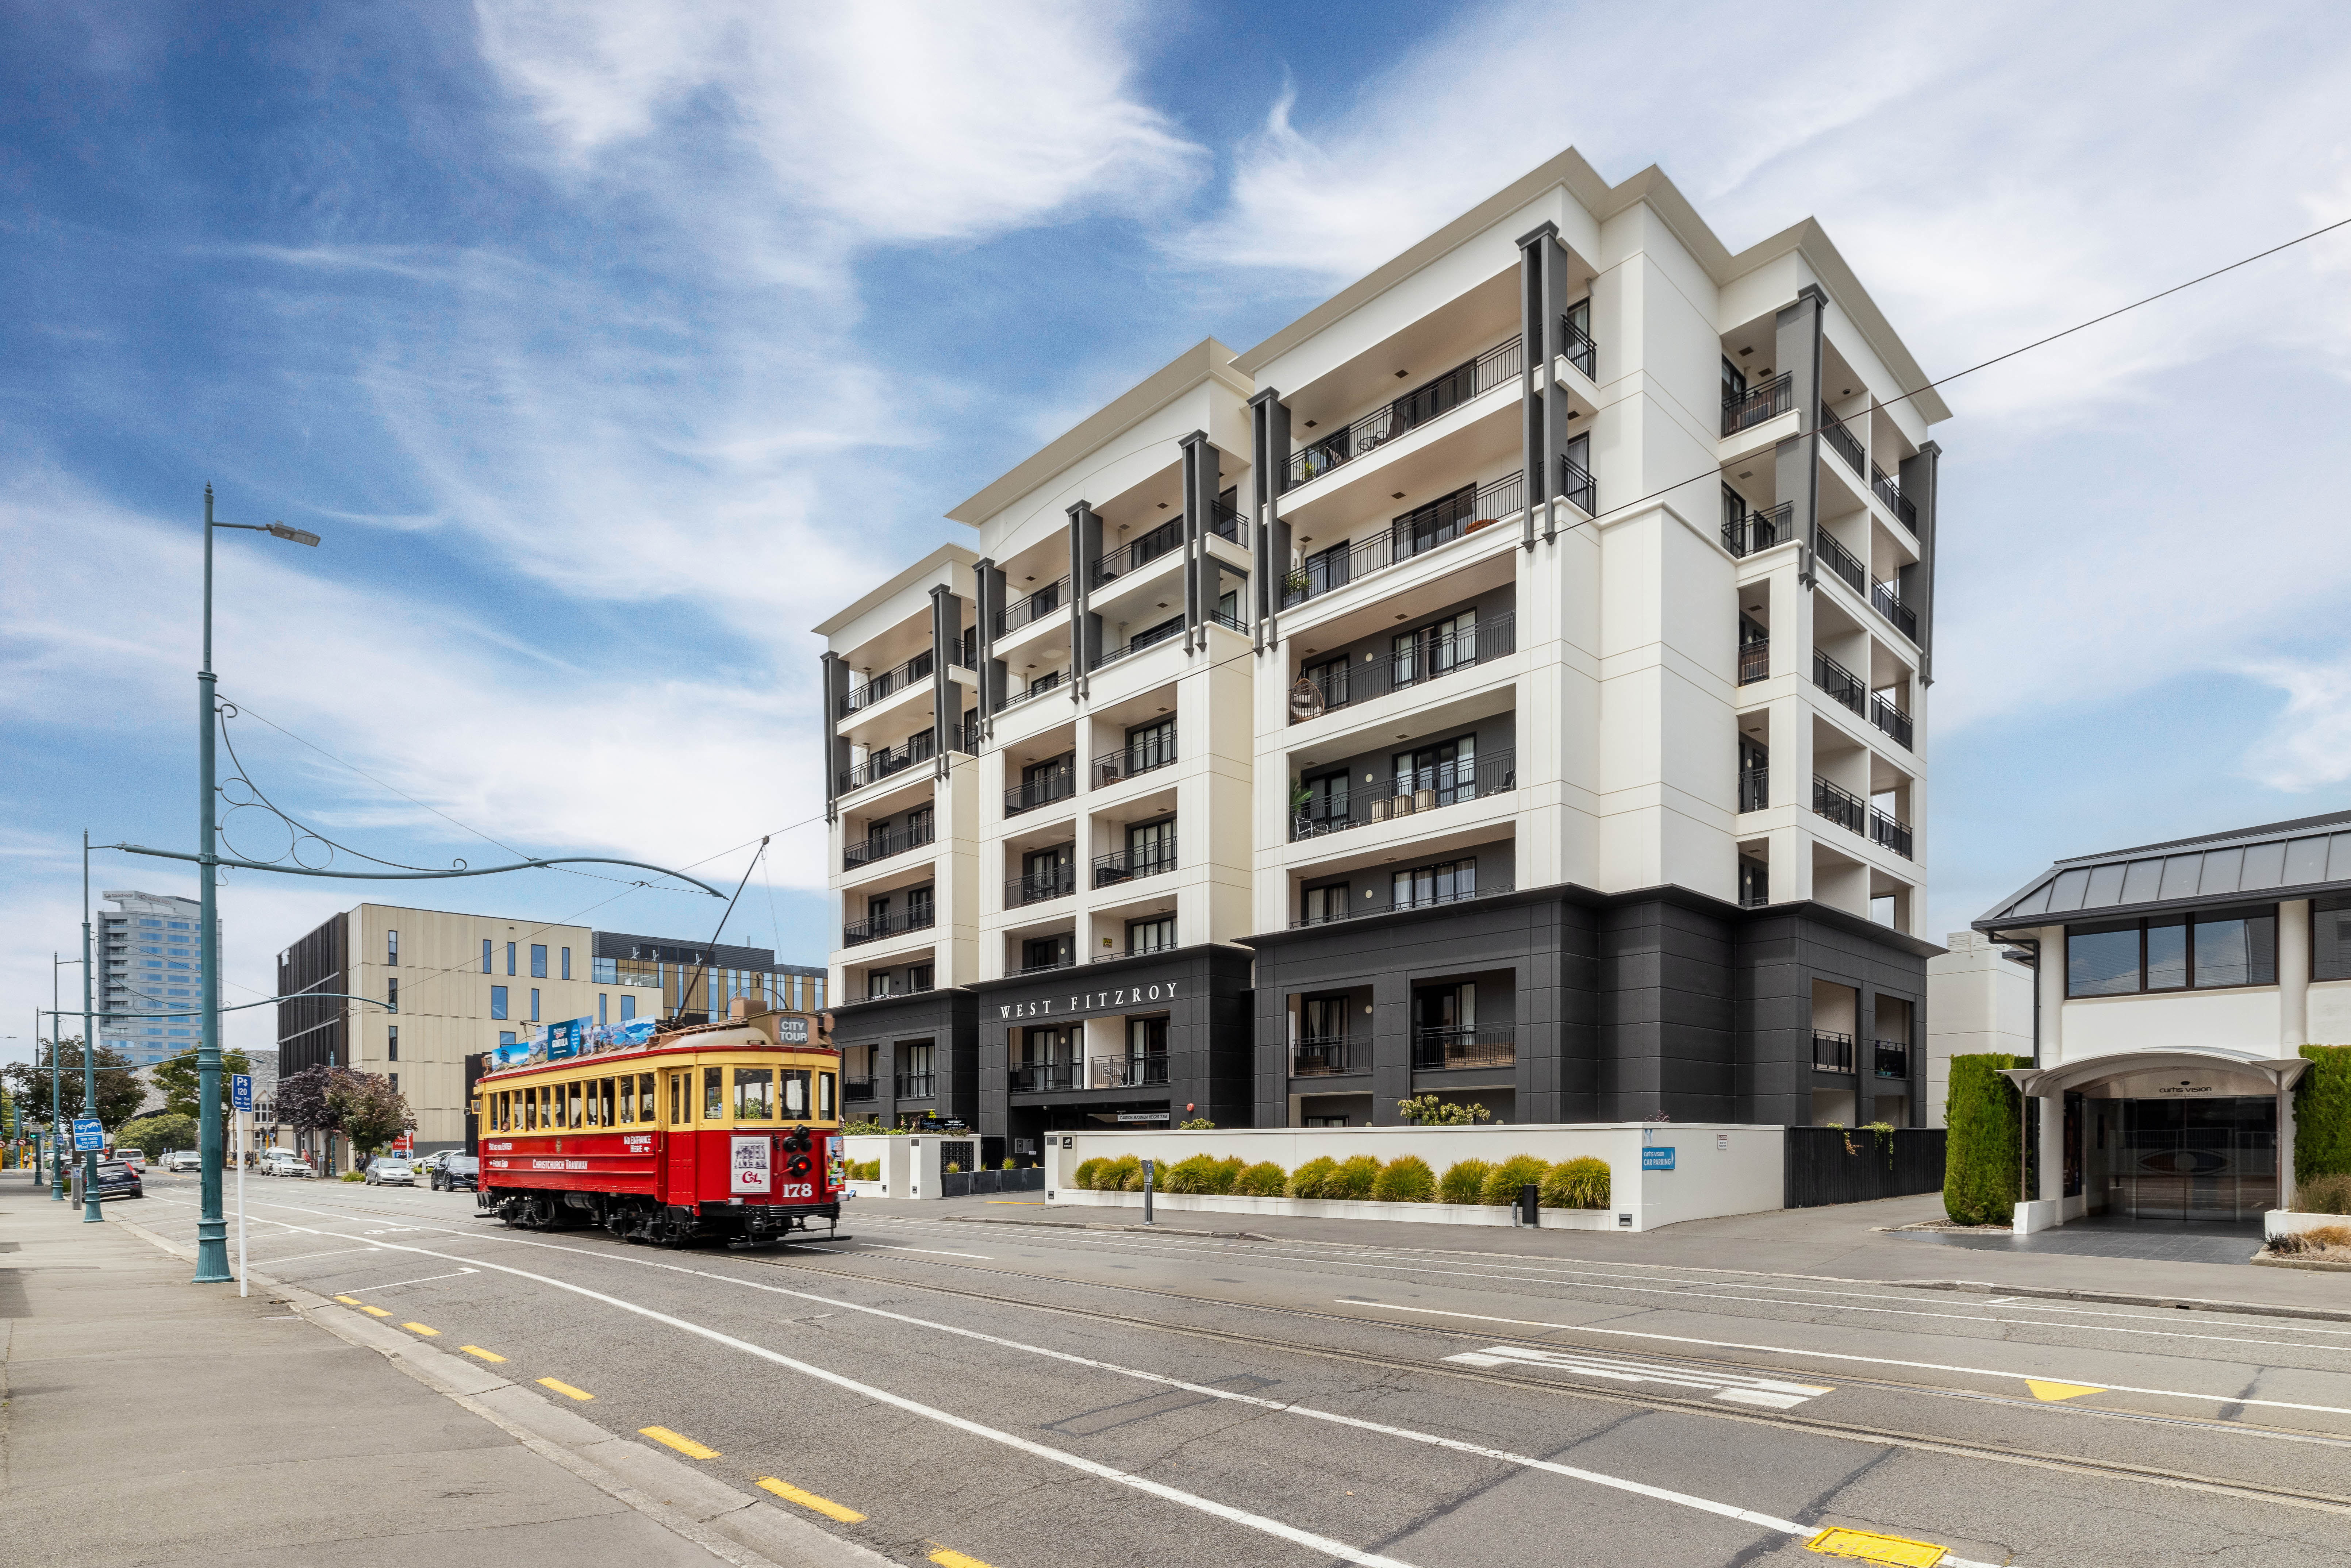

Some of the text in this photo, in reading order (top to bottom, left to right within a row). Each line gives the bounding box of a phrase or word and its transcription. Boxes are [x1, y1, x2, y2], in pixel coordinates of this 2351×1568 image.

[1000, 983, 1177, 1019] WEST FITZROY
[781, 1021, 805, 1031] CITY
[779, 1031, 807, 1041] TOUR
[624, 1135, 651, 1145] NO ENTRANCE
[533, 1159, 588, 1170] CHRISTCHURCH TRAMWAY
[783, 1183, 813, 1198] 178
